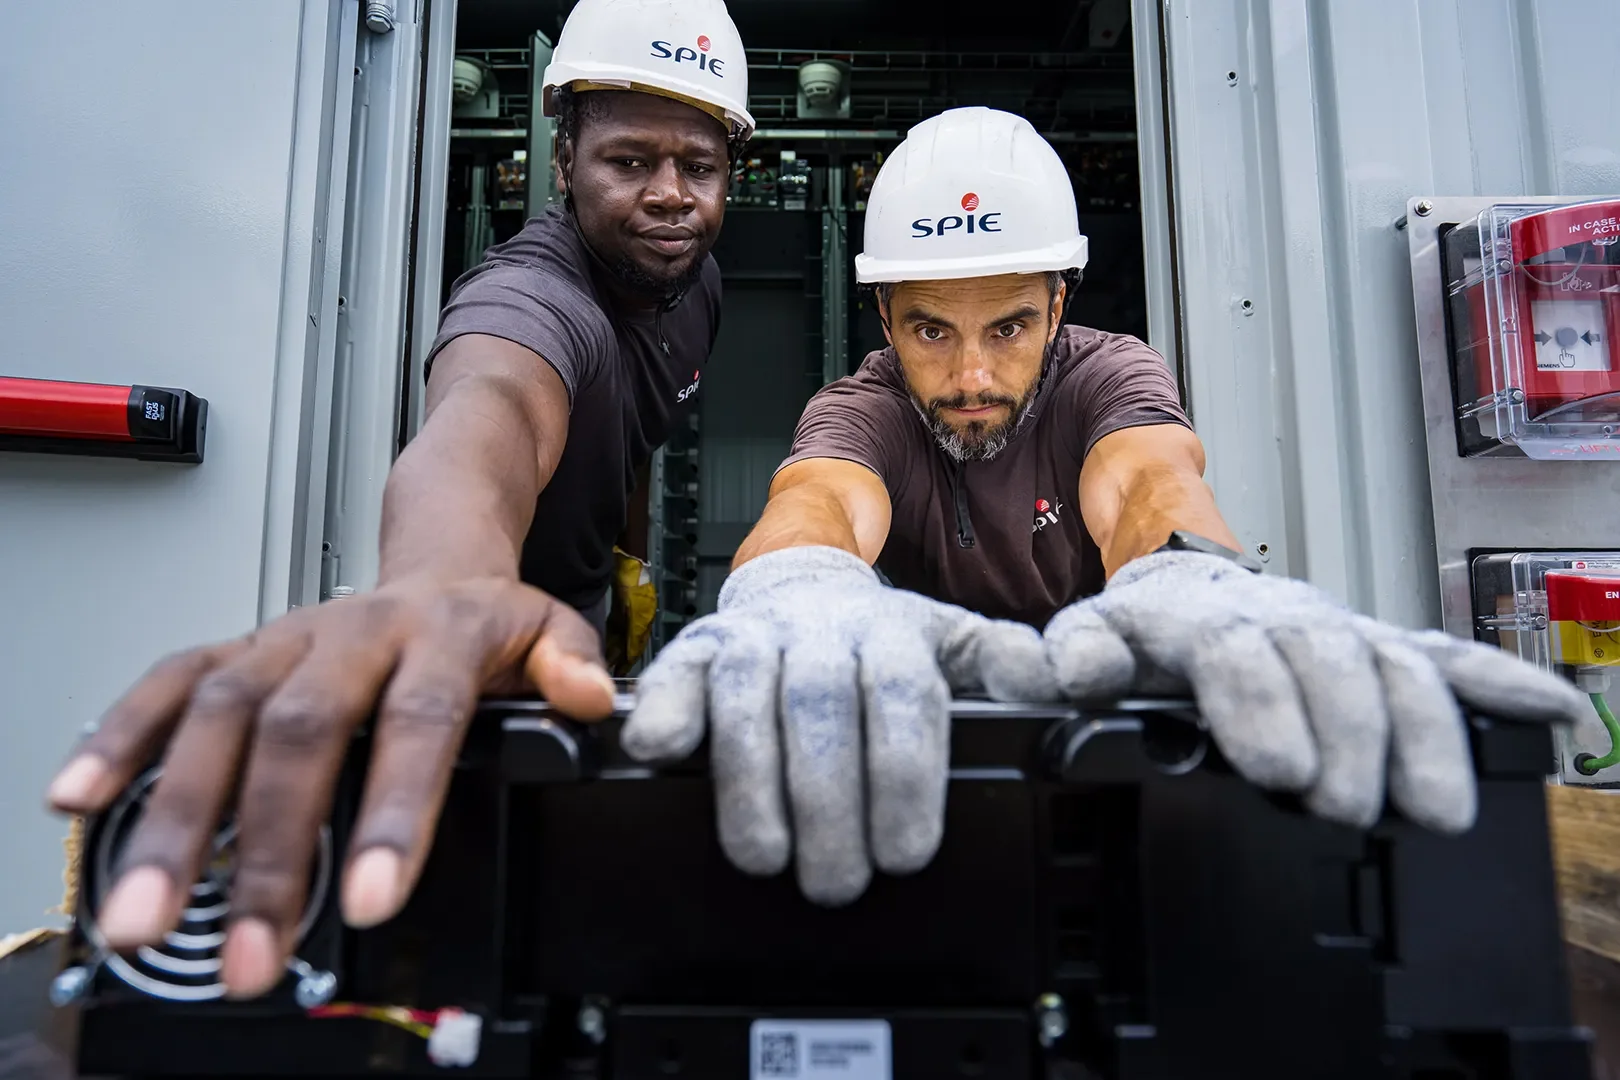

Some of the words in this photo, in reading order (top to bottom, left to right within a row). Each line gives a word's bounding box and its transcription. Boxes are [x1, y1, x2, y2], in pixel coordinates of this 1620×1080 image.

[650, 40, 725, 78] SPIE
[912, 212, 1002, 238] SPIE
[1568, 224, 1580, 234] IN
[1583, 217, 1617, 229] CASE
[1605, 591, 1620, 599] EN
